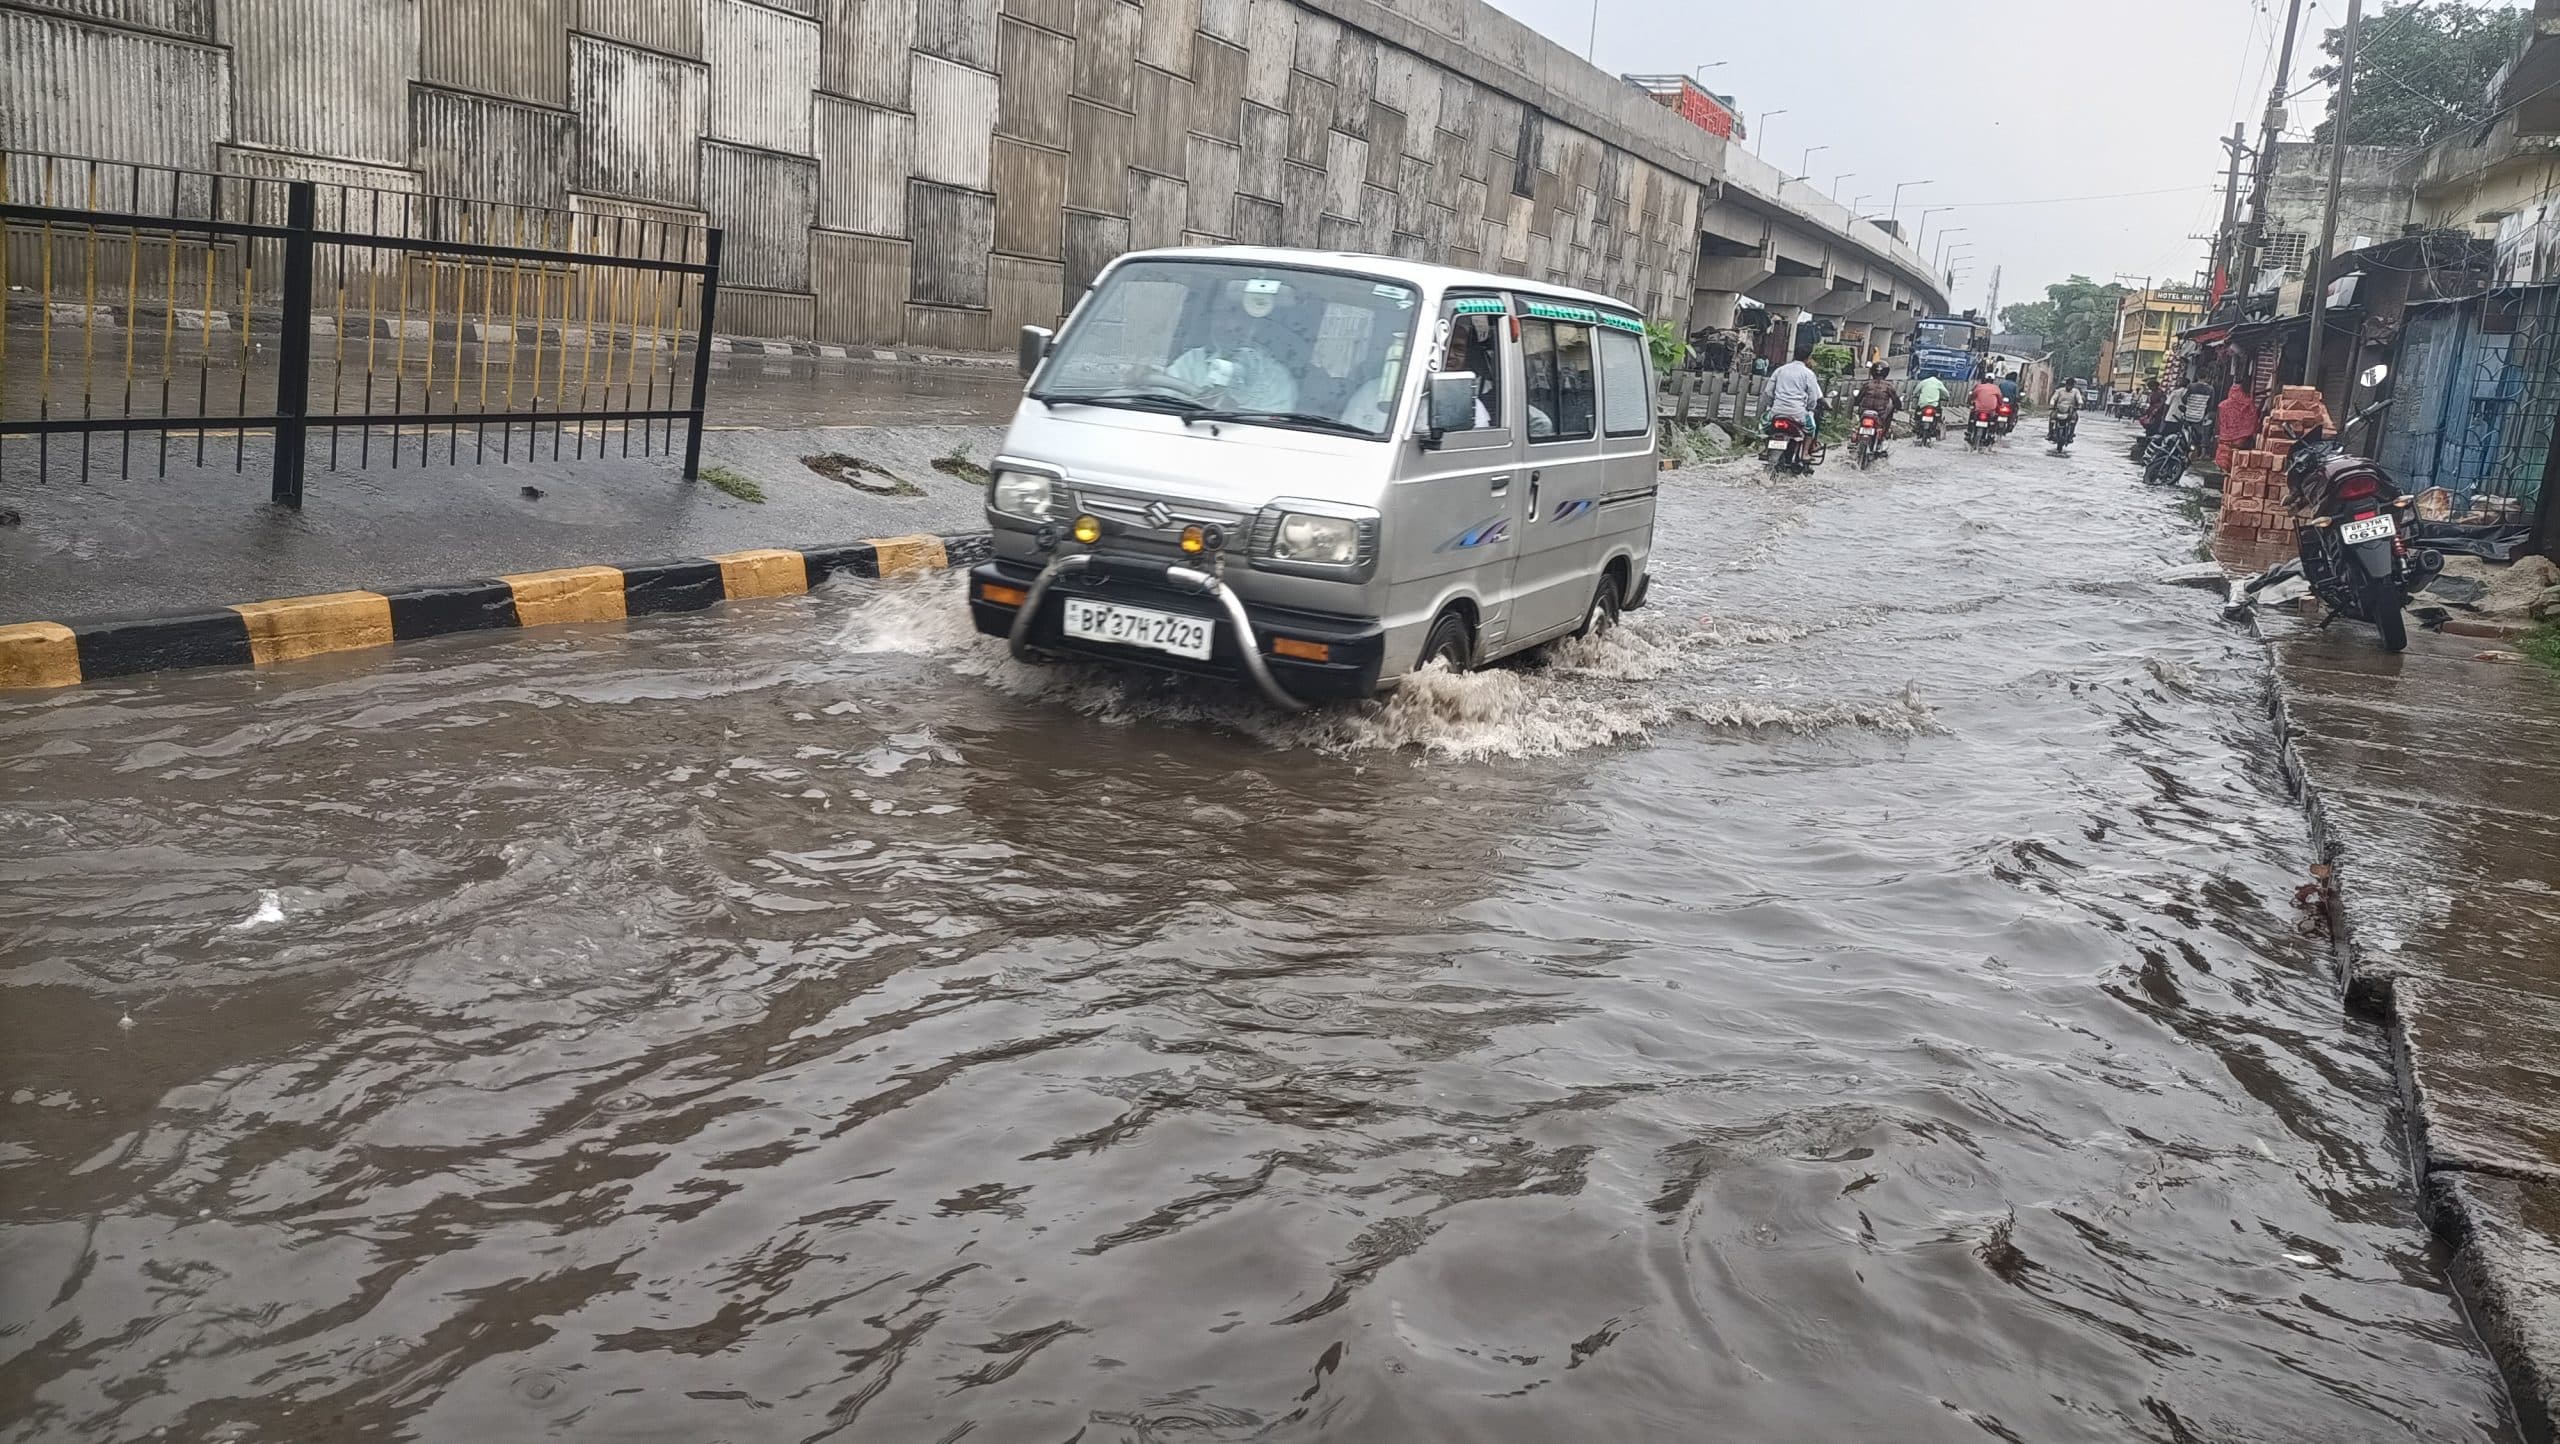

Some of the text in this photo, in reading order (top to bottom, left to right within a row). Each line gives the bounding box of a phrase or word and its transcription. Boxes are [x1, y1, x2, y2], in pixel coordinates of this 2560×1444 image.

[2157, 291, 2180, 300] HOTEL
[1456, 298, 1504, 314] OMNI
[1529, 303, 1595, 320] MARUTI
[2349, 527, 2388, 540] 0617
